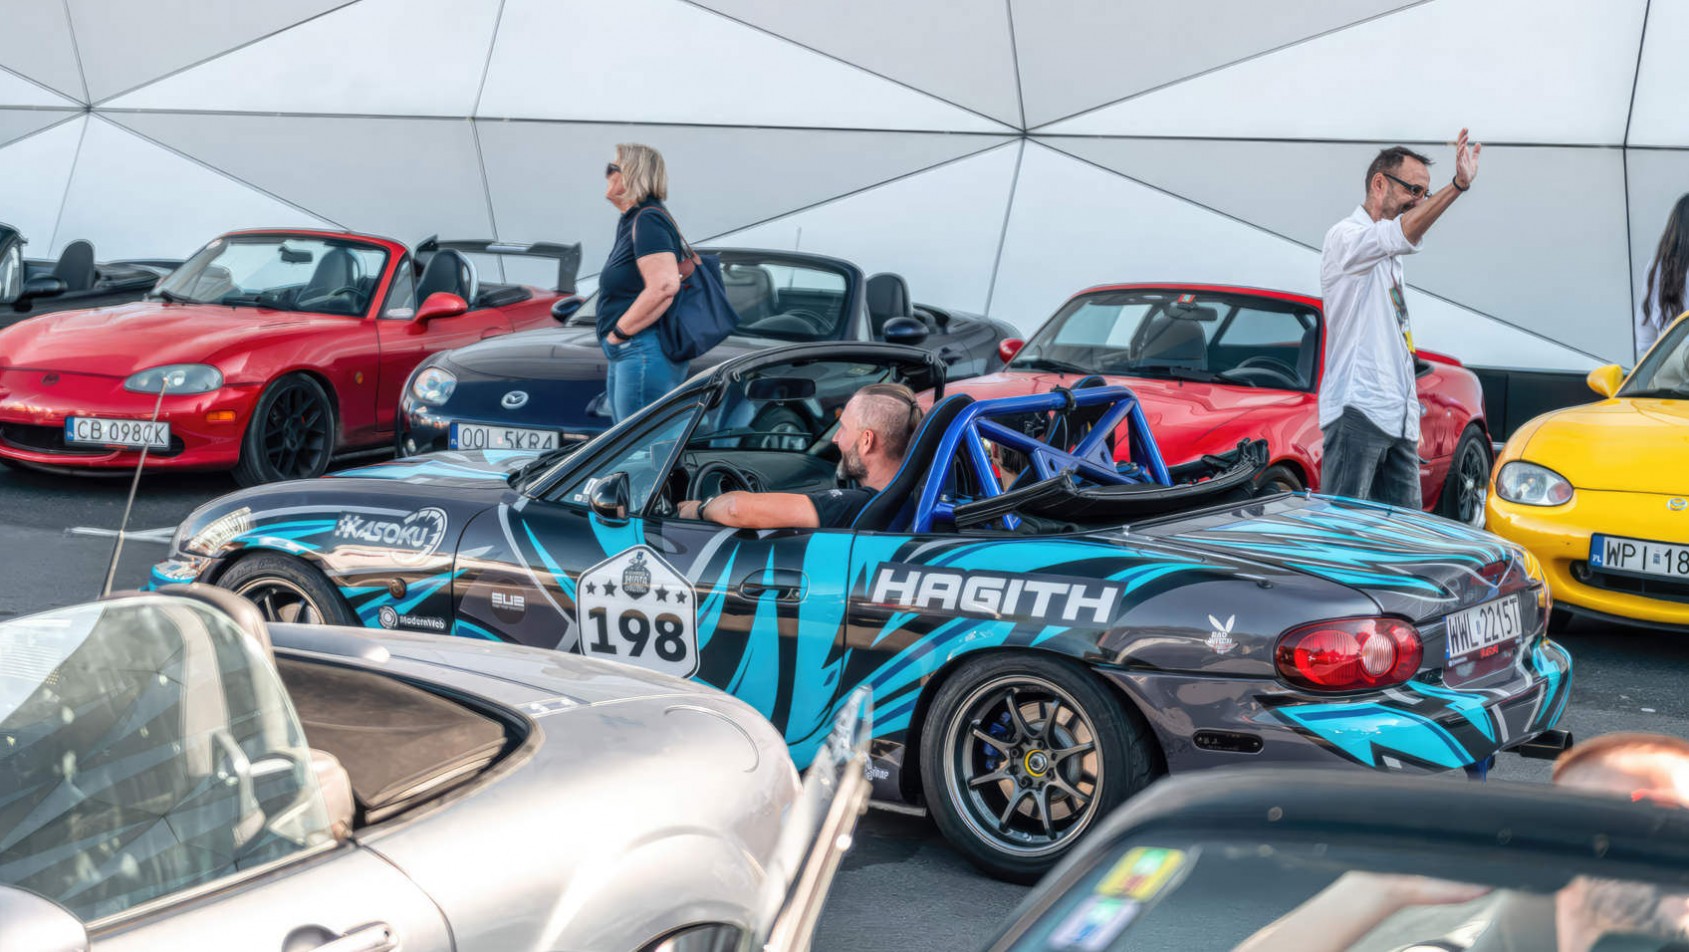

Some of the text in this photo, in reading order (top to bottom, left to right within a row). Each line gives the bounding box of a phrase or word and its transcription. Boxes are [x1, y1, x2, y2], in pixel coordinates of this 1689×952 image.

[77, 420, 102, 440] CB
[342, 516, 429, 548] KASOKU
[1606, 540, 1689, 575] WPI 18
[871, 568, 1119, 624] HAGITH
[588, 606, 688, 663] 198
[1448, 597, 1518, 655] WWL 2215T
